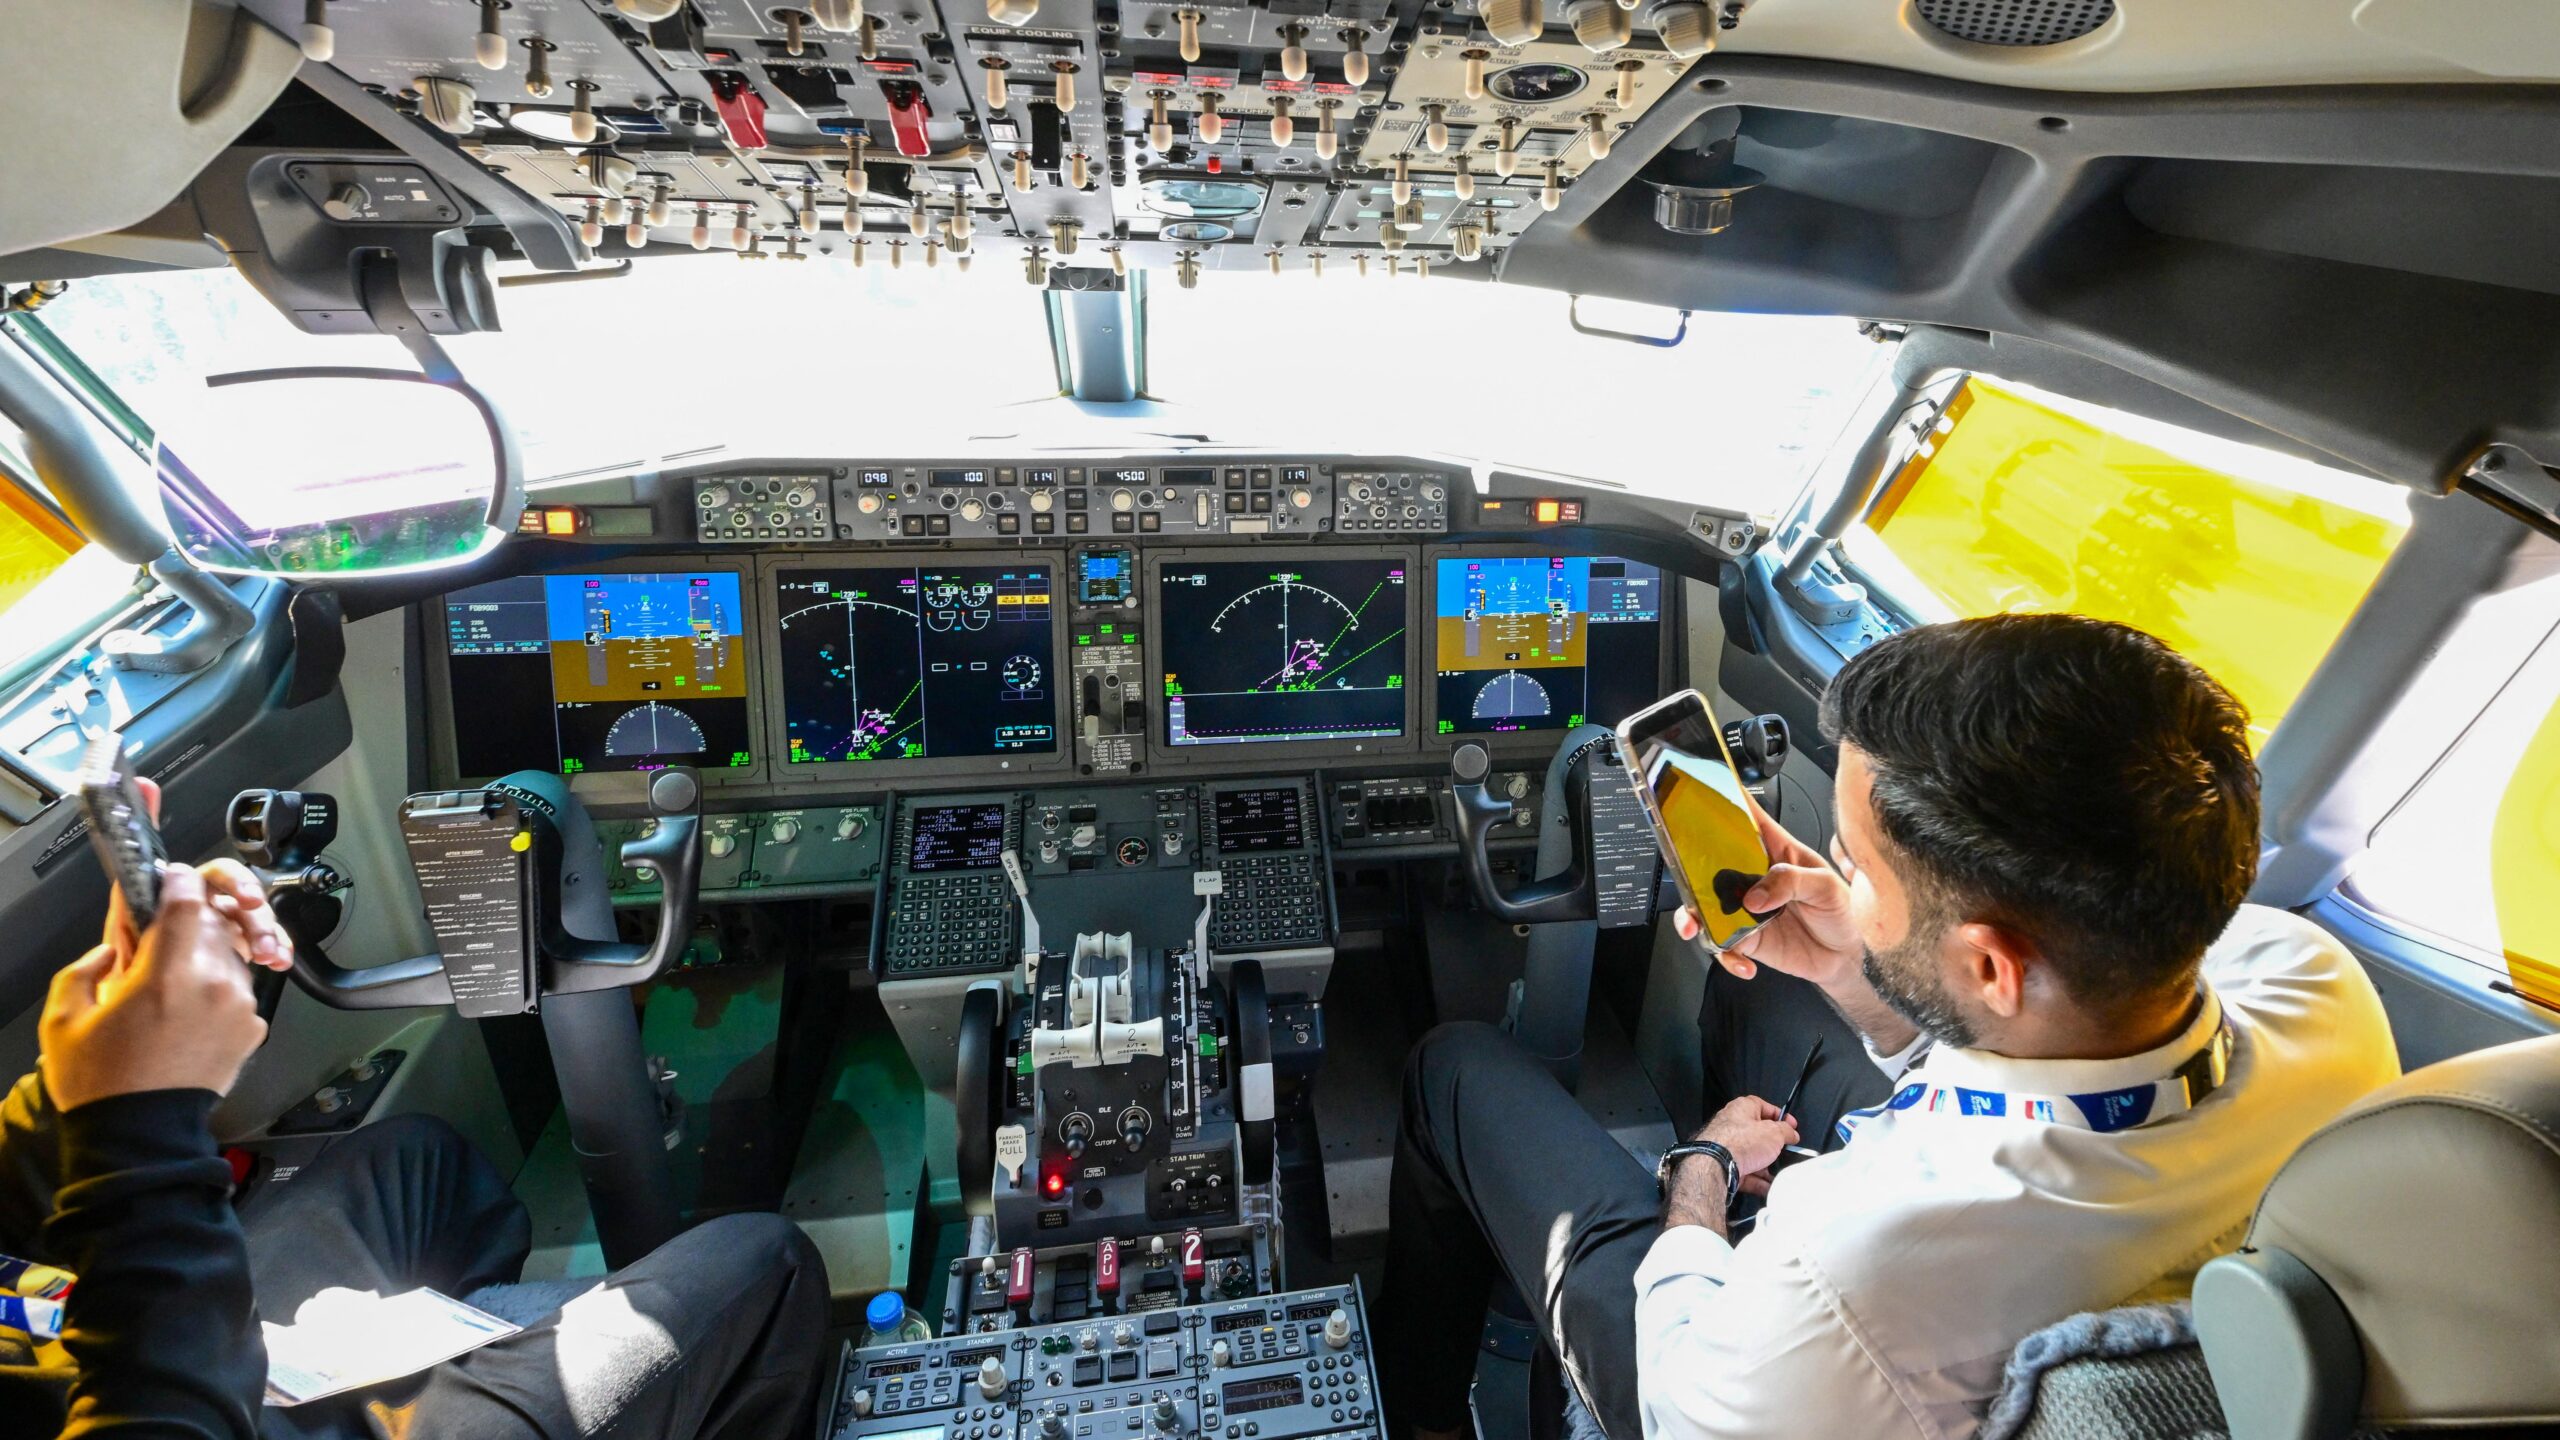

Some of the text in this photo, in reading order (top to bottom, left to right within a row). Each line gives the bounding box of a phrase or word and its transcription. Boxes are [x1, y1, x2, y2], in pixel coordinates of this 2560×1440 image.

[1296, 18, 1358, 28] ANTI-ICE
[971, 27, 1074, 38] EQUIP COOLING
[864, 472, 888, 483] 098
[964, 472, 984, 482] 100
[1034, 472, 1052, 481] 114
[1116, 471, 1145, 481] 4500
[1288, 470, 1304, 480] 119
[1128, 1029, 1136, 1041] 2
[1060, 1035, 1067, 1049] 1
[999, 1146, 1023, 1156] PULL
[1170, 1153, 1206, 1163] STAB TRIM
[1185, 1234, 1202, 1266] 2
[1103, 1243, 1113, 1276] APU
[1016, 1254, 1026, 1287] 1
[1301, 1292, 1327, 1301] STANDBY
[966, 1337, 994, 1346] STANDBY
[886, 1348, 909, 1356] ACTIVE
